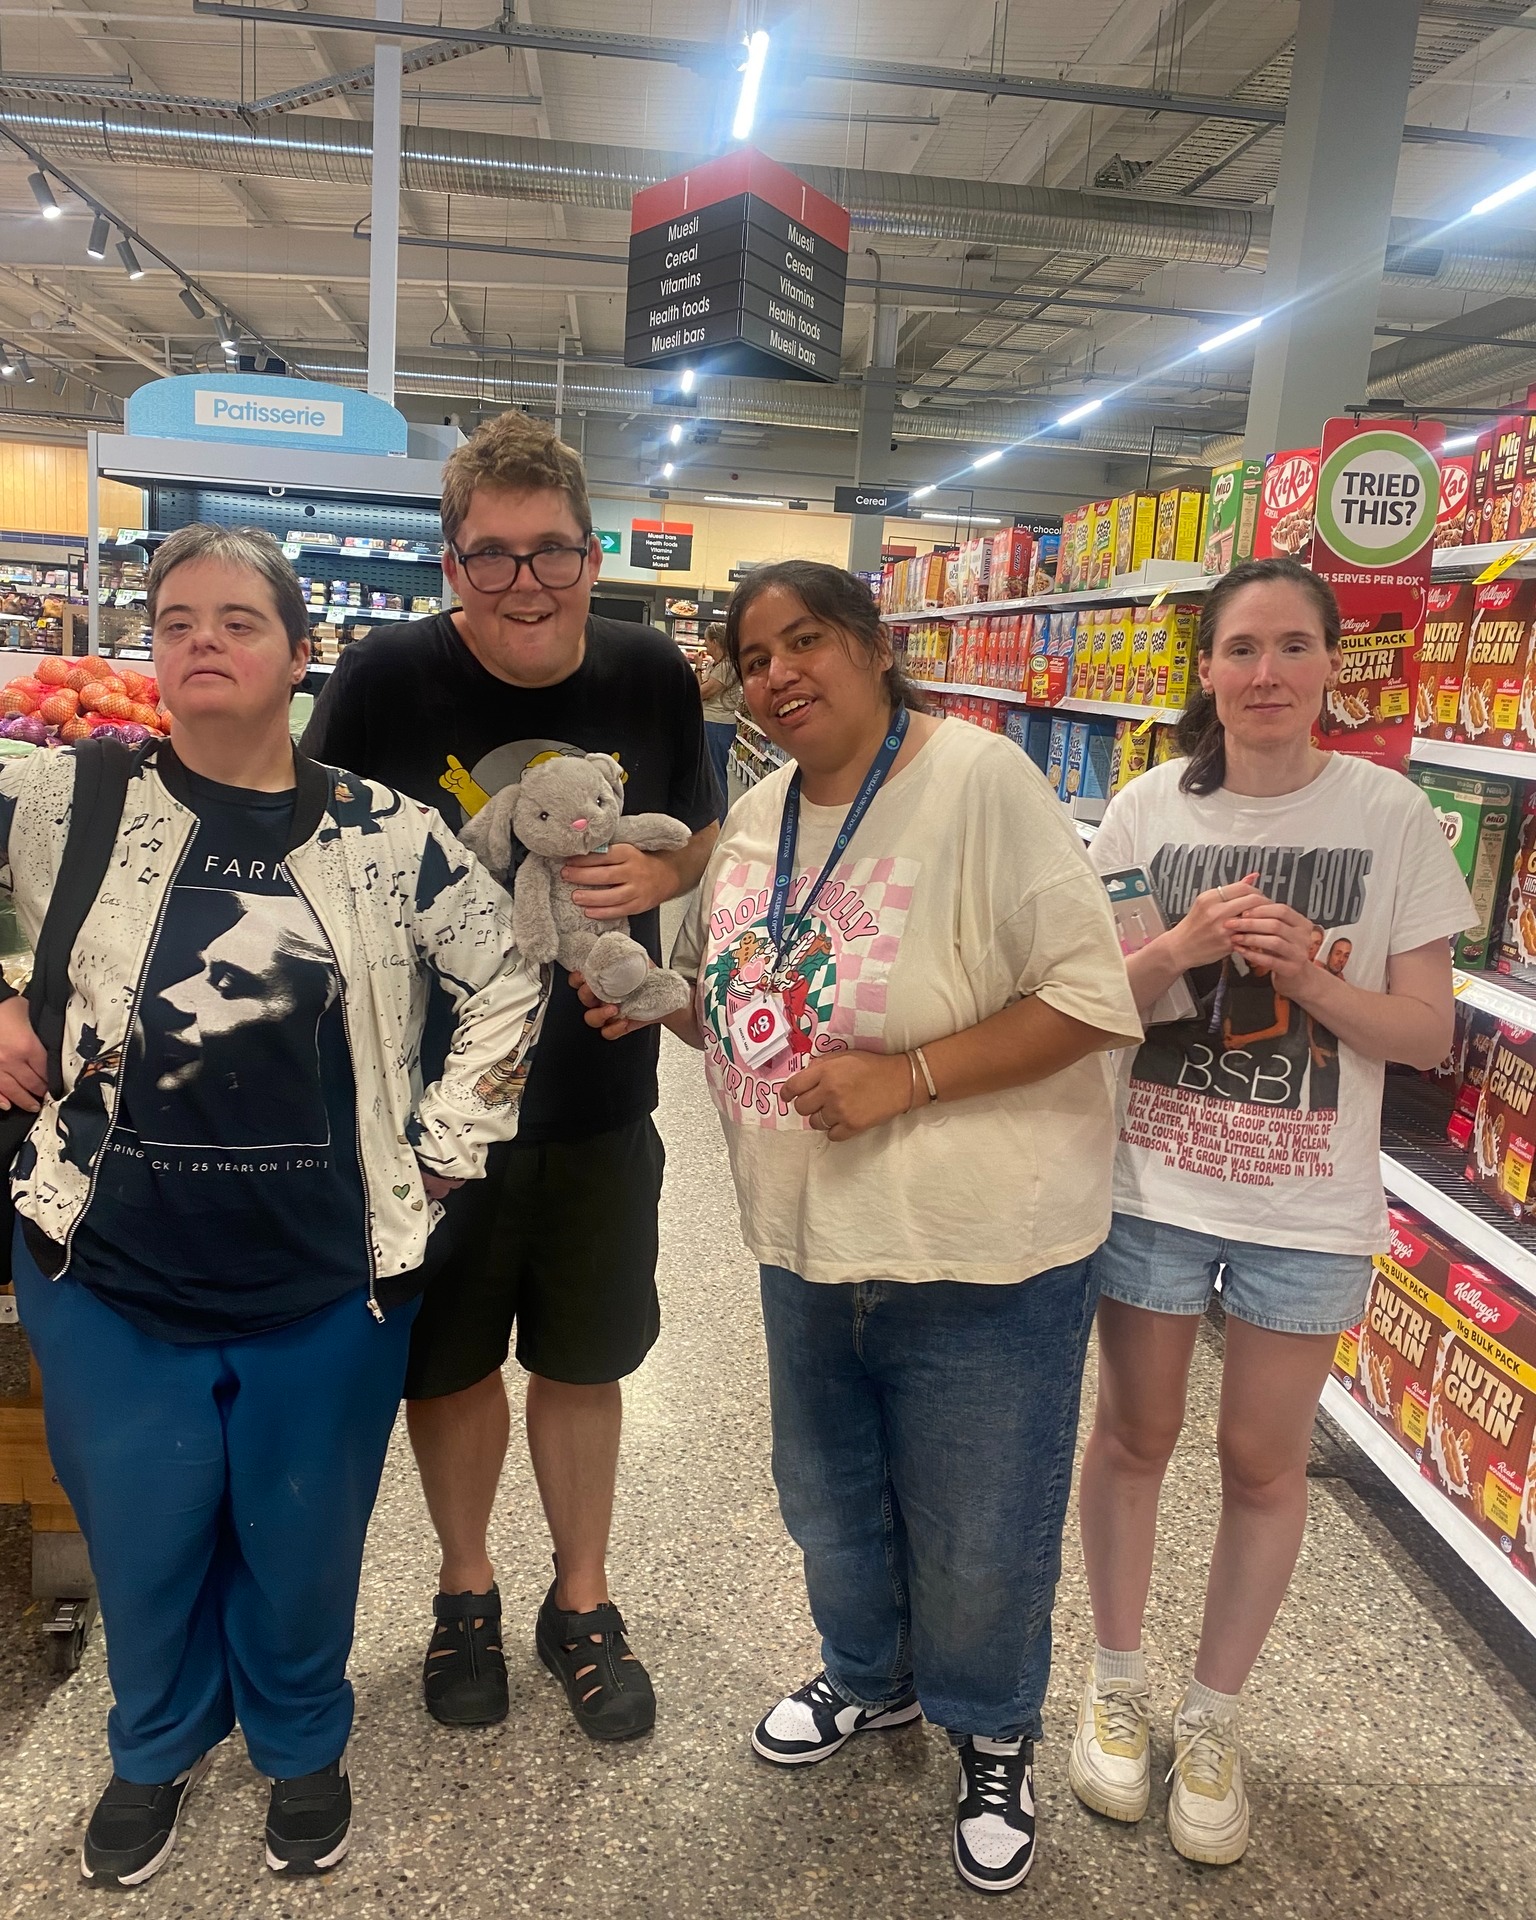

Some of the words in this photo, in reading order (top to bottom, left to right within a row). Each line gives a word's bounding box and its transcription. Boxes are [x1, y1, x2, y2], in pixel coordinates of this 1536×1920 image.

[668, 217, 699, 242] Muesli
[788, 224, 815, 254] Muesli
[665, 244, 698, 269] Cereal
[785, 252, 814, 282] Cereal
[660, 272, 701, 296] Vitamins
[780, 275, 815, 310] Vitamins
[650, 304, 679, 327] Health
[682, 296, 710, 318] foods
[768, 300, 796, 330] Health
[798, 318, 820, 340] foods
[651, 332, 680, 352] Muesli
[684, 327, 706, 346] bars
[770, 330, 796, 356] Muesli
[798, 344, 816, 366] bars
[214, 398, 326, 427] Patisserie
[1216, 482, 1231, 496] MILO
[1268, 460, 1312, 508] KitKat
[1342, 472, 1420, 498] TRIED
[855, 495, 888, 506] Cereal
[1341, 499, 1417, 526] THIS?
[650, 546, 673, 554] Vitamins
[652, 560, 669, 568] Muesli
[1332, 573, 1372, 584] SERVES
[1374, 575, 1394, 584] PER
[1479, 584, 1512, 606] Kellogg's
[1341, 637, 1372, 649] BULK
[1376, 633, 1406, 645] PACK
[1472, 642, 1521, 664] GRAIN
[1339, 664, 1392, 684] GRAIN
[847, 795, 867, 830] GOULBURN
[865, 768, 881, 796] OPTIONS
[1155, 842, 1304, 916] BACKSTREET
[1305, 848, 1374, 923] BOYS
[710, 876, 808, 940] HOLY
[1177, 1044, 1291, 1104] BSB
[1129, 1079, 1174, 1098] BACKSTREET
[1177, 1087, 1200, 1104] BOYS
[1203, 1095, 1235, 1112] (OFTEN
[1238, 1103, 1302, 1120] ABBREVIATED
[1306, 1114, 1314, 1122] AS
[1317, 1108, 1338, 1125] BSB)
[1490, 1070, 1532, 1115] GRAIN
[1127, 1102, 1146, 1119] NICK
[1148, 1108, 1184, 1130] CARTER,
[1188, 1116, 1218, 1136] HOWIE
[1220, 1125, 1272, 1148] DOROUGH,
[1275, 1132, 1289, 1149] AJ
[1137, 1093, 1151, 1106] AN
[1152, 1095, 1197, 1117] AMERICAN
[1200, 1108, 1228, 1125] VOCAL
[1232, 1115, 1265, 1130] GROUP
[1268, 1121, 1319, 1136] CONSISTING
[1322, 1124, 1331, 1135] OF
[1130, 1120, 1149, 1134] AND
[1152, 1125, 1189, 1143] COUSINS
[1192, 1132, 1221, 1151] BRIAN
[1224, 1140, 1265, 1159] LITTRELL
[1268, 1149, 1289, 1161] AND
[1292, 1149, 1320, 1163] KEVIN
[192, 1162, 209, 1171] 25
[216, 1163, 254, 1172] YEARS
[260, 1162, 278, 1172] ON
[296, 1159, 328, 1169] 2011
[1164, 1155, 1175, 1167] IN
[1179, 1156, 1226, 1182] ORLANDO,
[1230, 1168, 1274, 1186] FLORIDA.
[1177, 1142, 1193, 1158] THE
[1196, 1150, 1227, 1166] GROUP
[1231, 1157, 1251, 1171] WAS
[1254, 1161, 1291, 1176] FORMED
[1295, 1165, 1305, 1177] IN
[1309, 1162, 1333, 1177] 1993
[1389, 1228, 1414, 1259] llogg's
[1379, 1256, 1389, 1274] 1kg
[1391, 1266, 1408, 1288] BULK
[1409, 1278, 1429, 1303] PACK
[1454, 1282, 1500, 1323] Kellogg's
[1370, 1306, 1425, 1369] GRAIN
[1456, 1319, 1469, 1339] 1kg
[1470, 1329, 1493, 1355] BULK
[1495, 1348, 1520, 1374] PACK
[1444, 1374, 1515, 1446] GRAIN
[1497, 1462, 1516, 1479] Real
